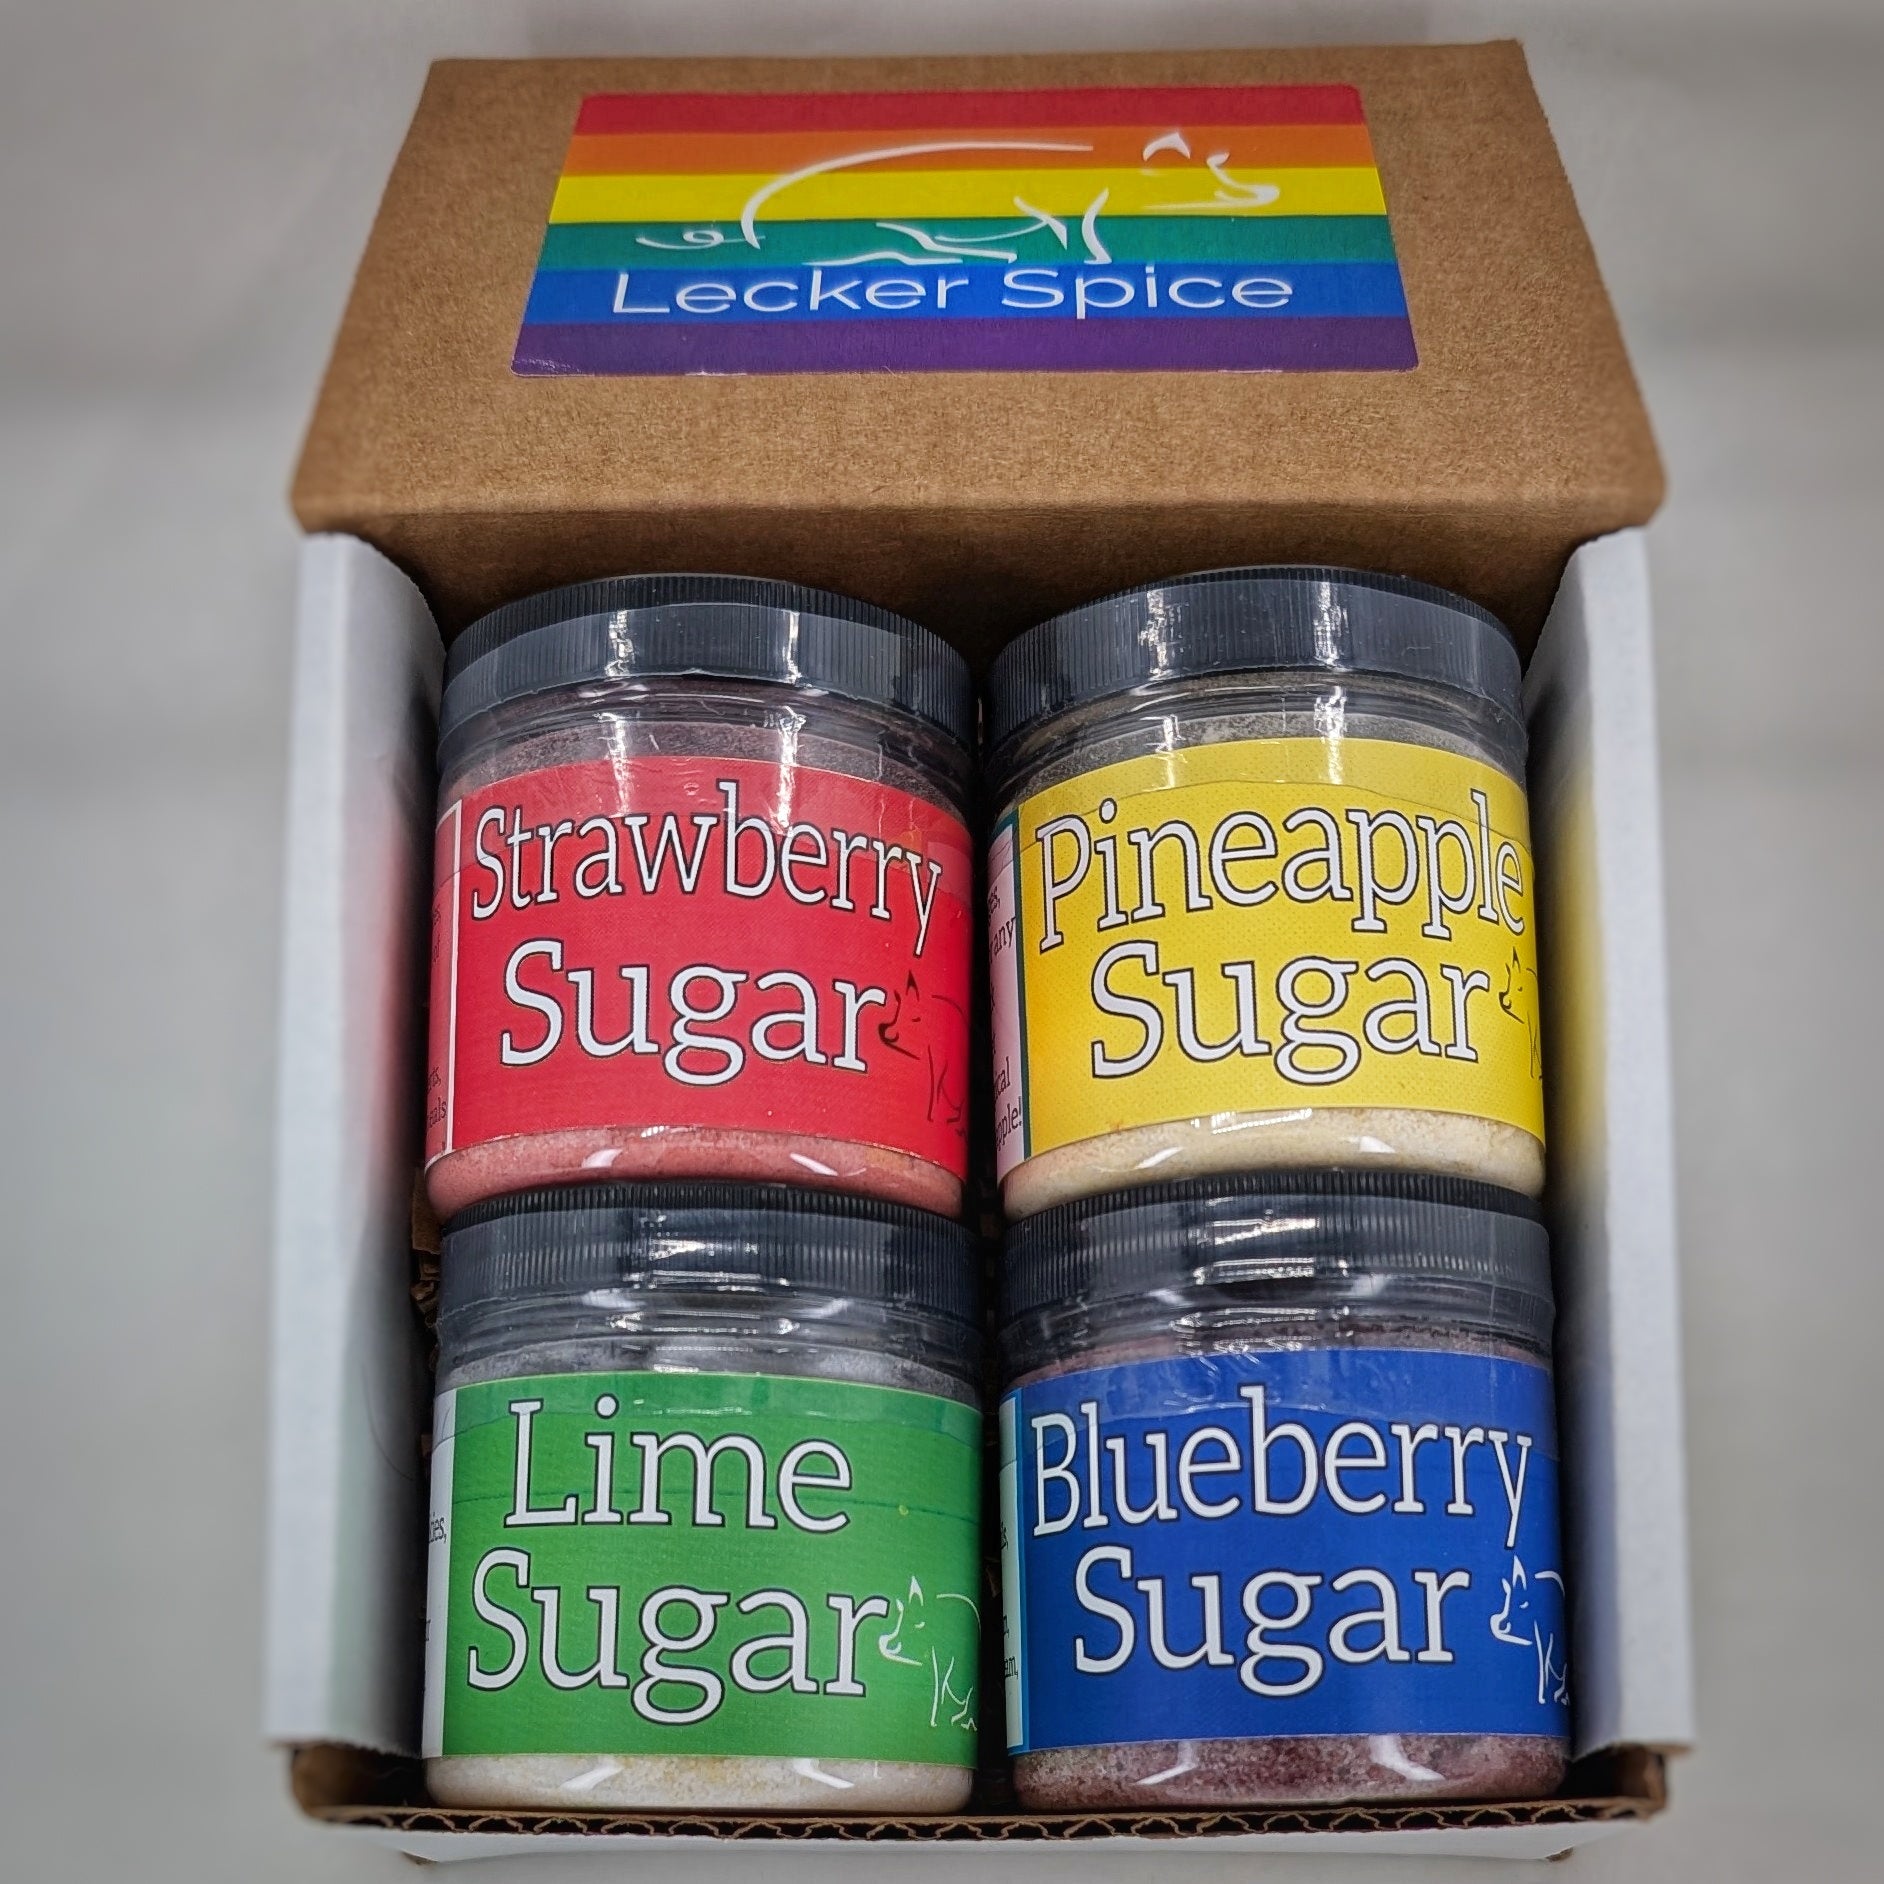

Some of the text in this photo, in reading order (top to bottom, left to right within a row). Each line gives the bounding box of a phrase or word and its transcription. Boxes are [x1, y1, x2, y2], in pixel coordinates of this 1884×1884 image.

[611, 264, 1294, 320] Lecker Spice
[472, 778, 943, 957] Strawberry
[1035, 788, 1525, 954] Pineapple
[500, 938, 886, 1086] Sugar
[1091, 939, 1491, 1086] Sugar
[504, 1393, 853, 1534] Lime
[1031, 1382, 1533, 1548] Blueberry
[467, 1547, 891, 1725] Sugar
[1074, 1544, 1472, 1697] Sugar
